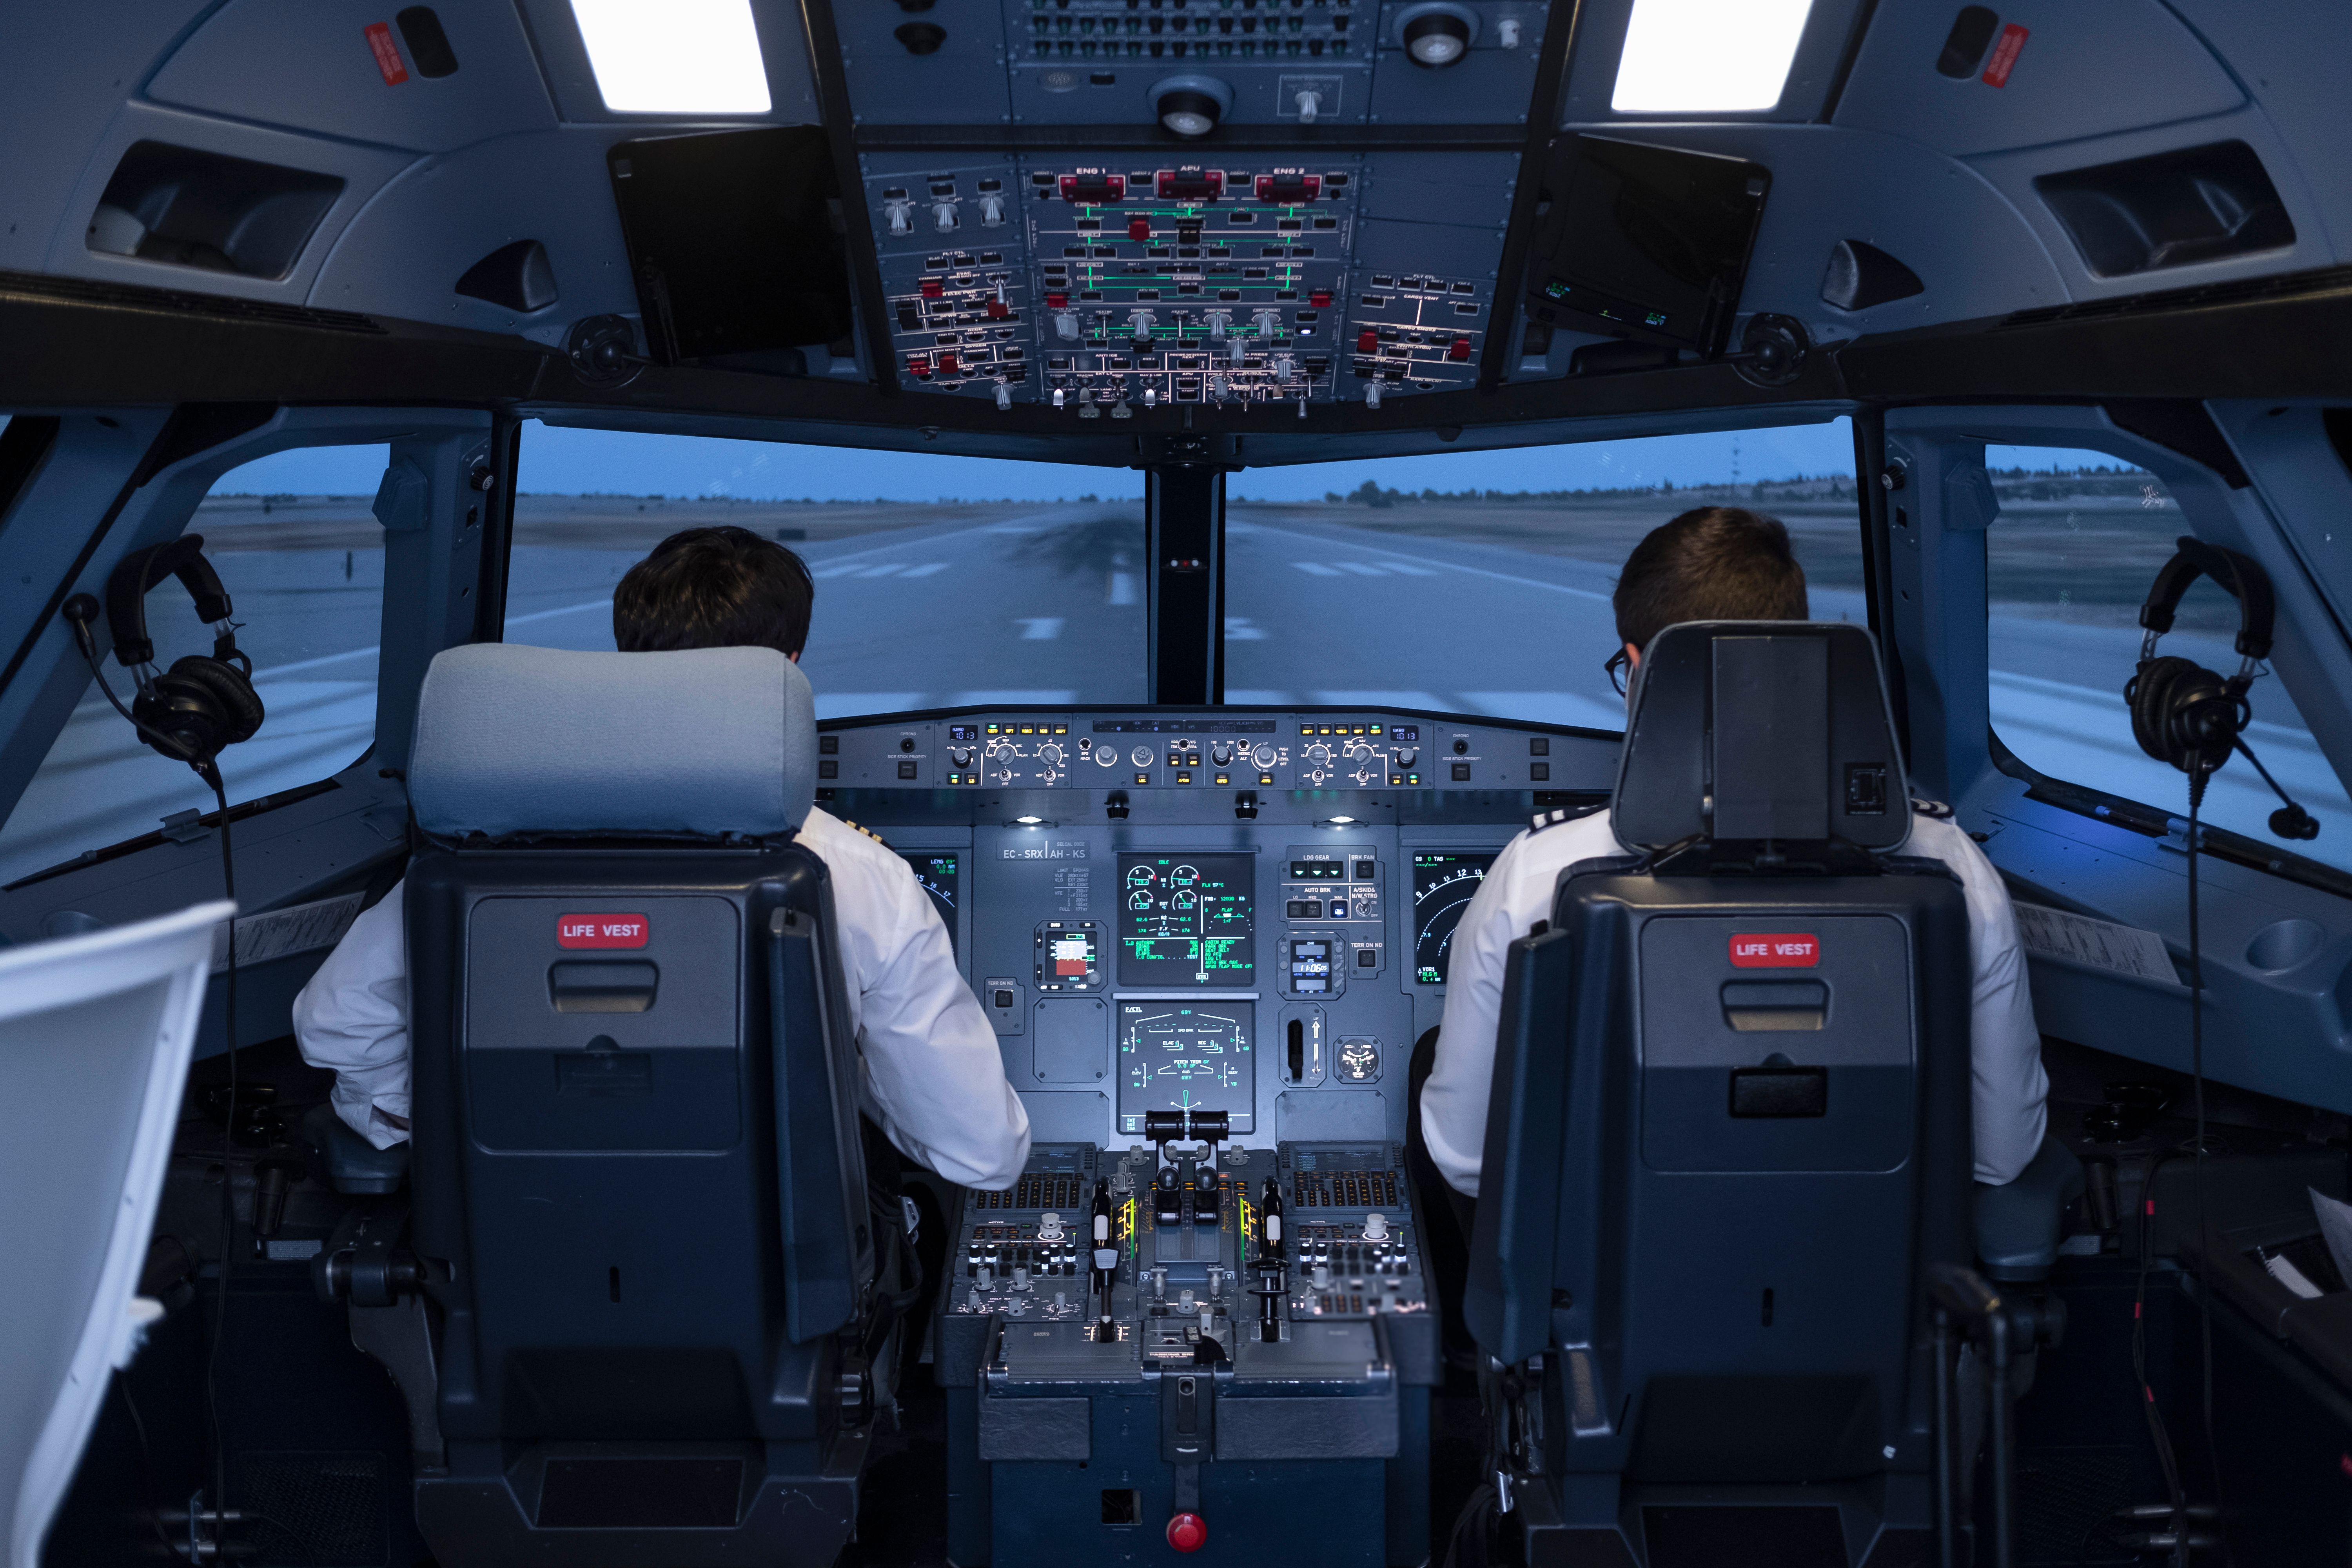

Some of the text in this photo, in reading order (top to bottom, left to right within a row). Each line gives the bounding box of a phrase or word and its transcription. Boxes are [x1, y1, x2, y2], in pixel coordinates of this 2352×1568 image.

[564, 925, 640, 936] LIFE VEST
[1736, 944, 1812, 955] LIFE VEST
